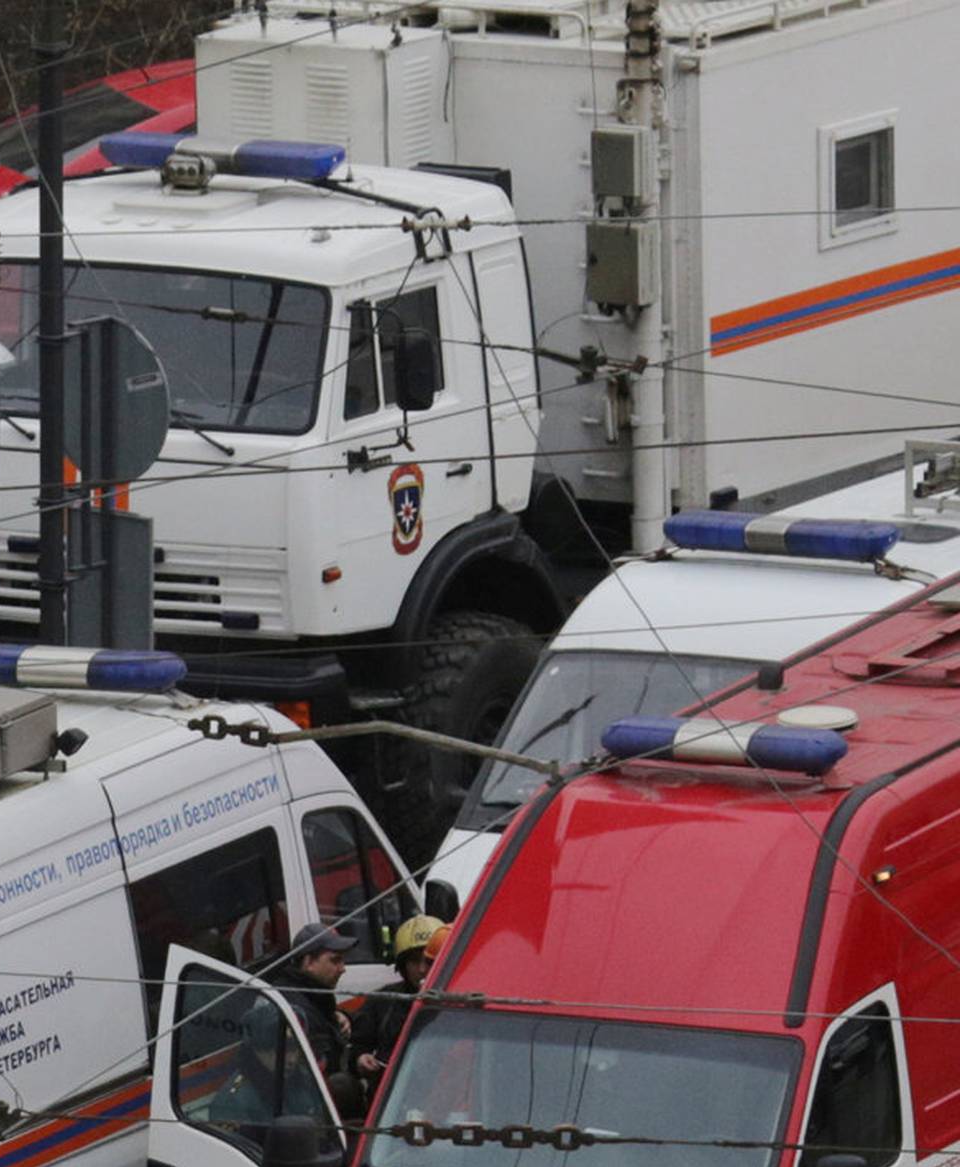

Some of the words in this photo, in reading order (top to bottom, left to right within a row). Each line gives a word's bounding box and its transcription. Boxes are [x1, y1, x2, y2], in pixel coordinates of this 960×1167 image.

[65, 817, 171, 876] правопорядка
[172, 815, 182, 833] и
[182, 773, 280, 828] безопасности
